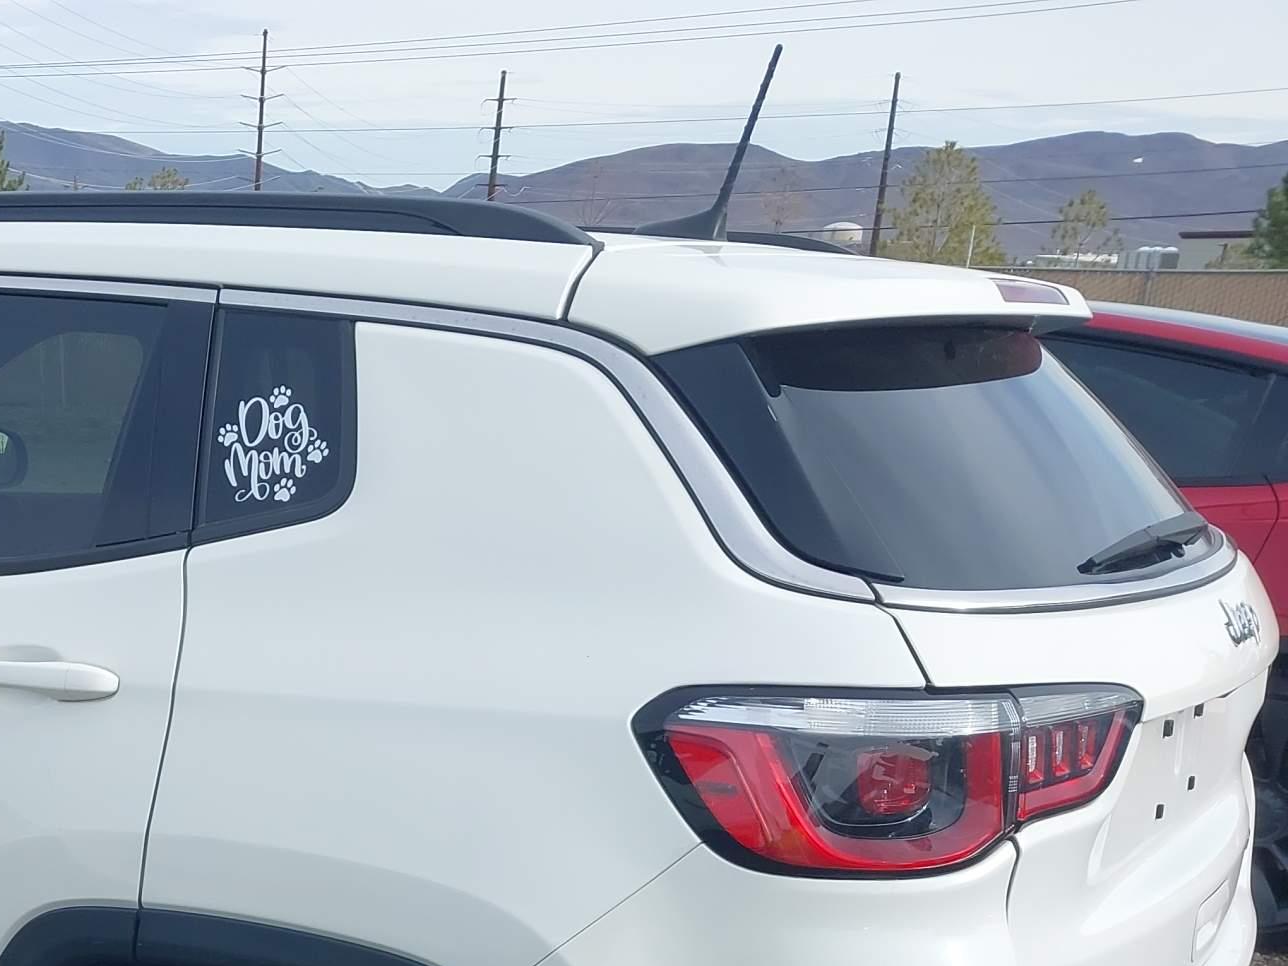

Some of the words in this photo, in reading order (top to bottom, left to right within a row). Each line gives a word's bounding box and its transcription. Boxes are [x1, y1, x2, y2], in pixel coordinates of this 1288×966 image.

[238, 396, 318, 454] Dog
[224, 442, 307, 502] Mom
[1217, 599, 1261, 648] Jeep
